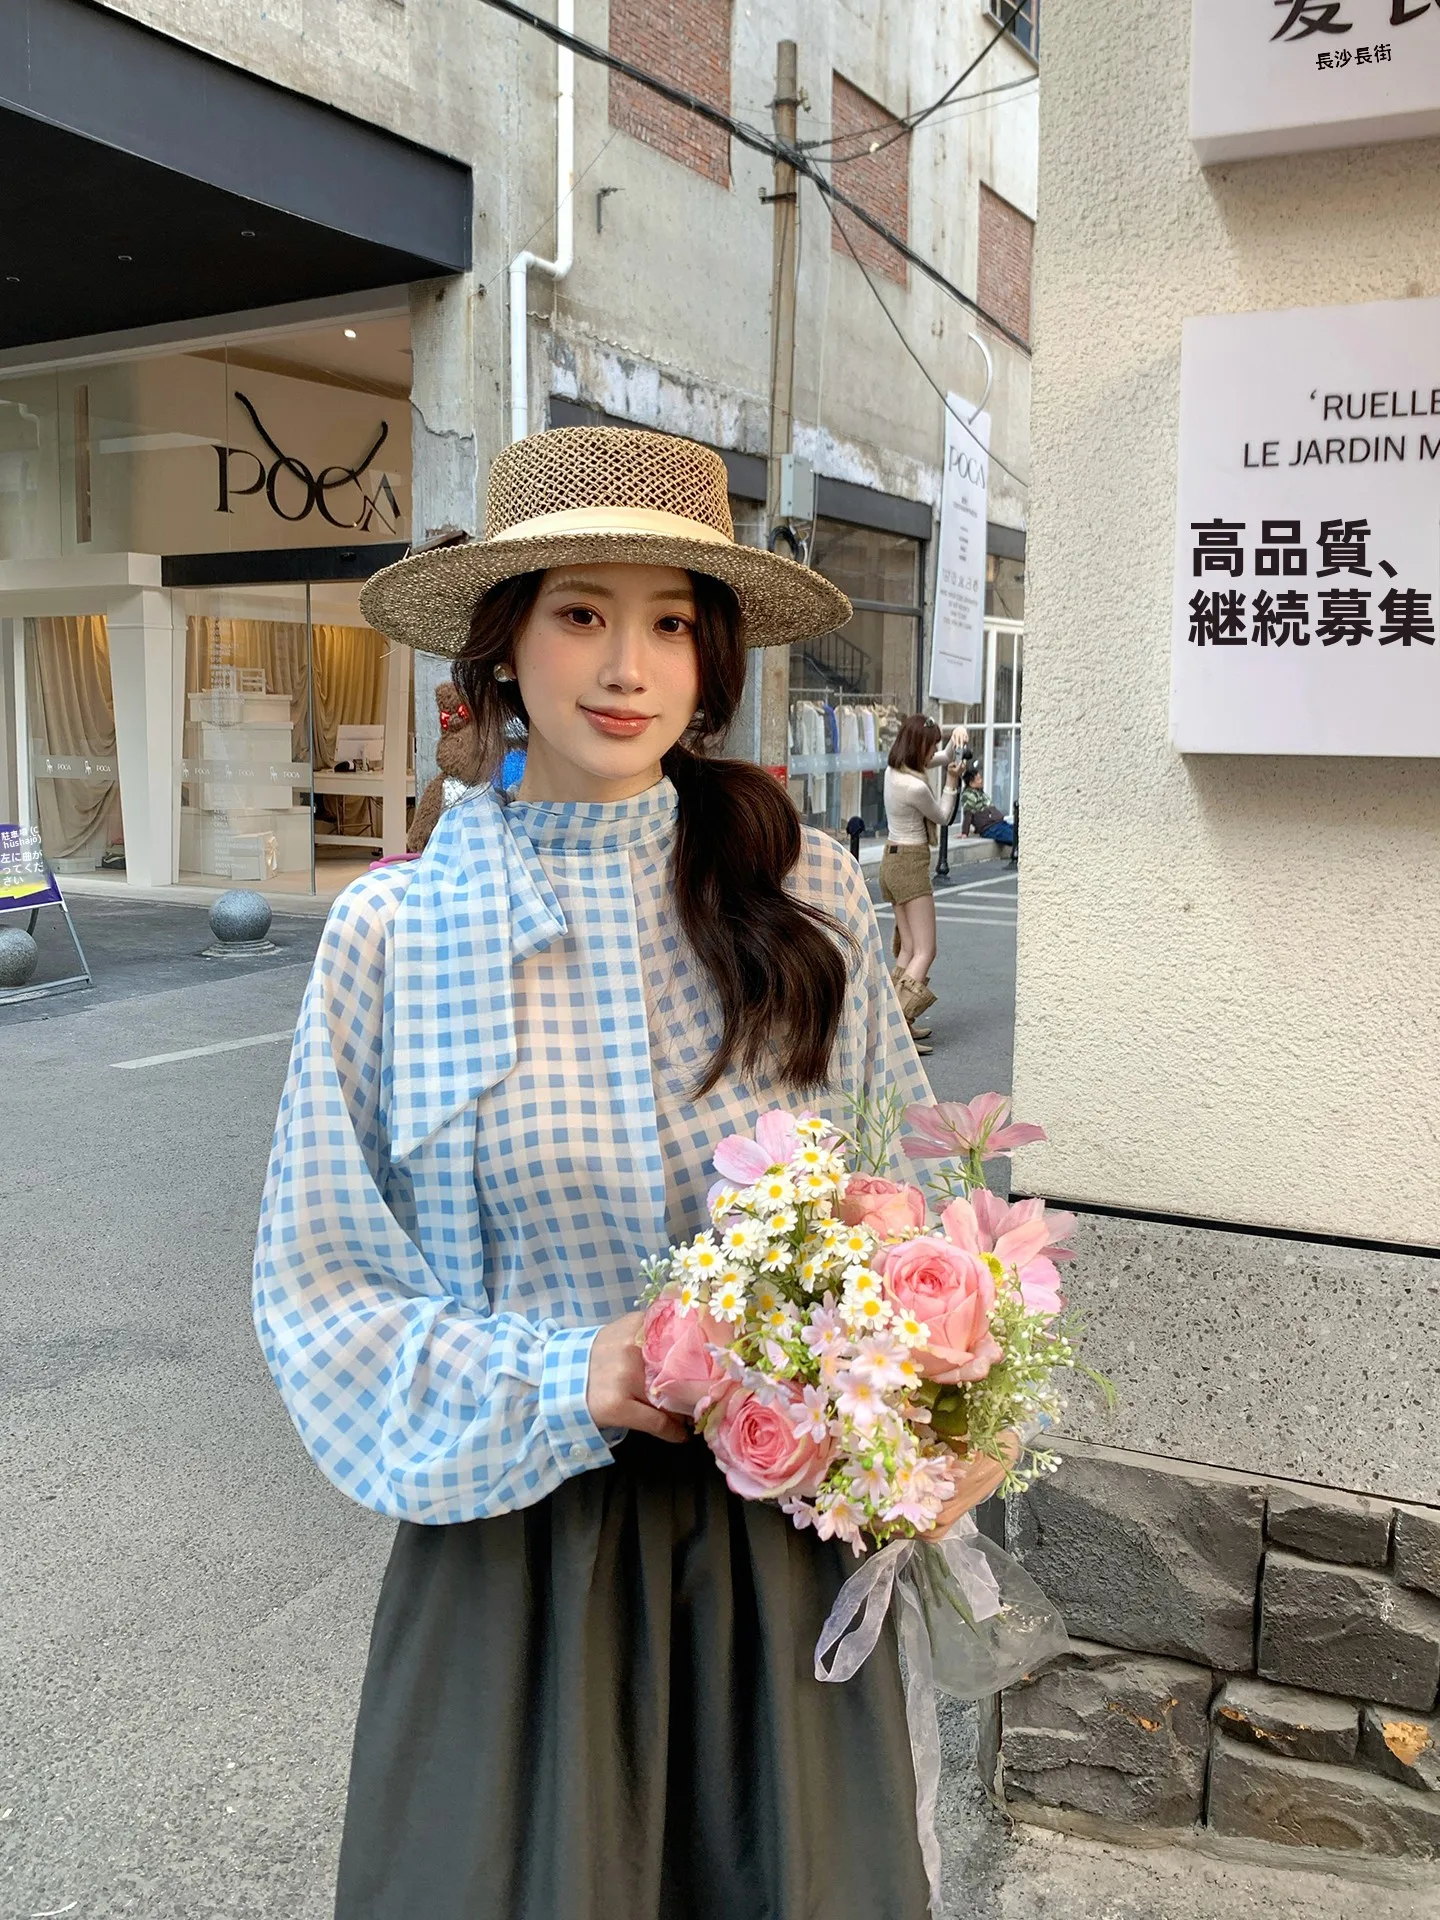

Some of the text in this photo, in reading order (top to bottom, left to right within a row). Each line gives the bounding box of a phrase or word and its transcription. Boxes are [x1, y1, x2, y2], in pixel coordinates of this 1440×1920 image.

[1315, 43, 1392, 70] 長沙長街
[1243, 441, 1280, 468] LE
[1289, 435, 1405, 466] JARDIN
[949, 445, 986, 489] POCA
[211, 444, 401, 535] POCA
[1187, 587, 1436, 647] 継続募集
[1, 850, 42, 864] 左に曲が
[3, 861, 44, 875] ってくだ
[3, 876, 24, 887] さい
